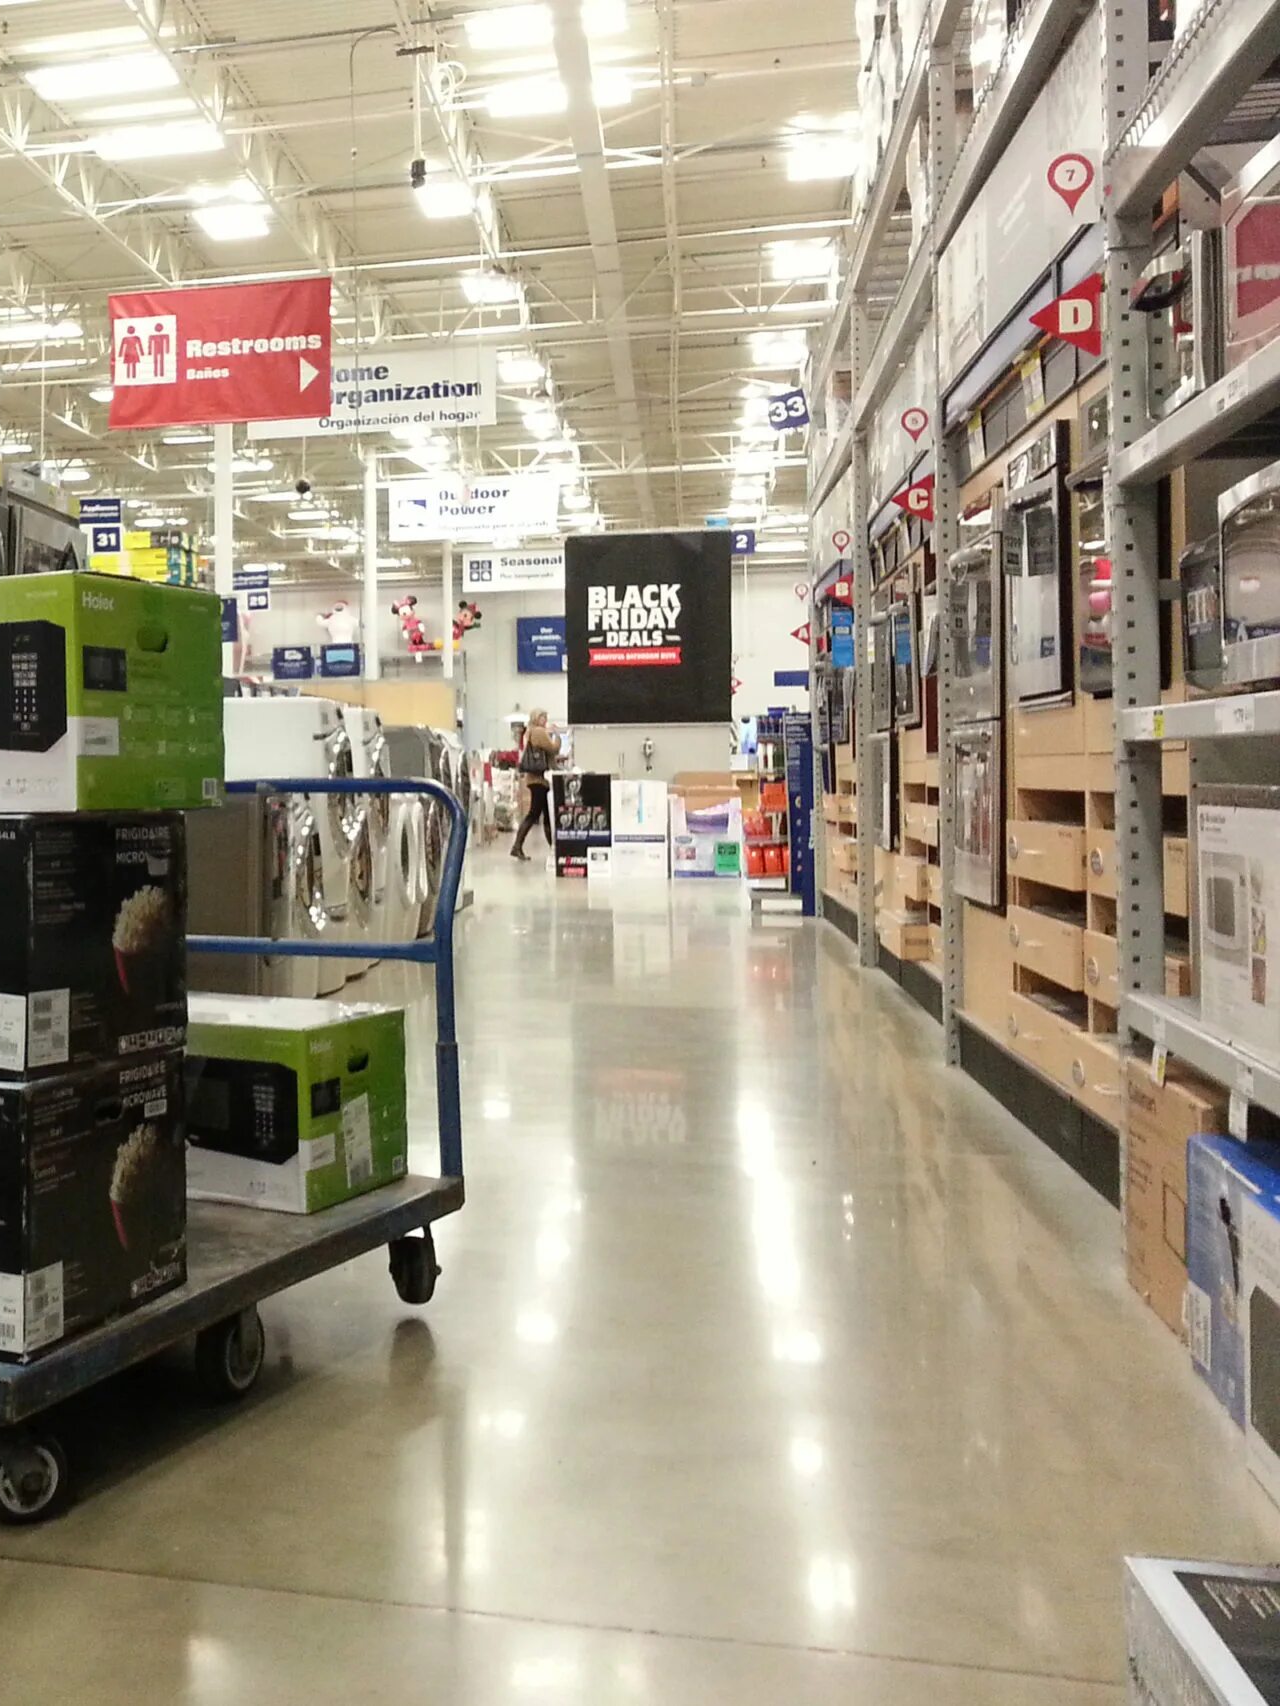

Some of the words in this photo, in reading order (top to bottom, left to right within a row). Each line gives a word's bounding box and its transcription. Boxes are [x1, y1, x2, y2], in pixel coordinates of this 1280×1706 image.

[1065, 169, 1076, 182] 7
[1059, 299, 1093, 334] D
[186, 334, 322, 358] Restrooms
[186, 367, 230, 380] Baños
[331, 379, 481, 409] rganization
[769, 395, 807, 423] 33
[319, 413, 409, 431] Organización
[414, 411, 435, 423] del
[439, 409, 481, 424] hogar
[439, 488, 510, 501] Oudoor
[908, 488, 929, 510] C
[439, 504, 496, 516] Power
[97, 533, 117, 547] 31
[735, 534, 748, 549] 2
[500, 555, 563, 567] Seasonal
[588, 583, 681, 609] BLACK
[588, 607, 681, 631] FRIDAY
[606, 630, 663, 647] DEALS
[115, 826, 170, 840] FRIGIDAIRE
[120, 1060, 166, 1084] FRIGIDAIRE
